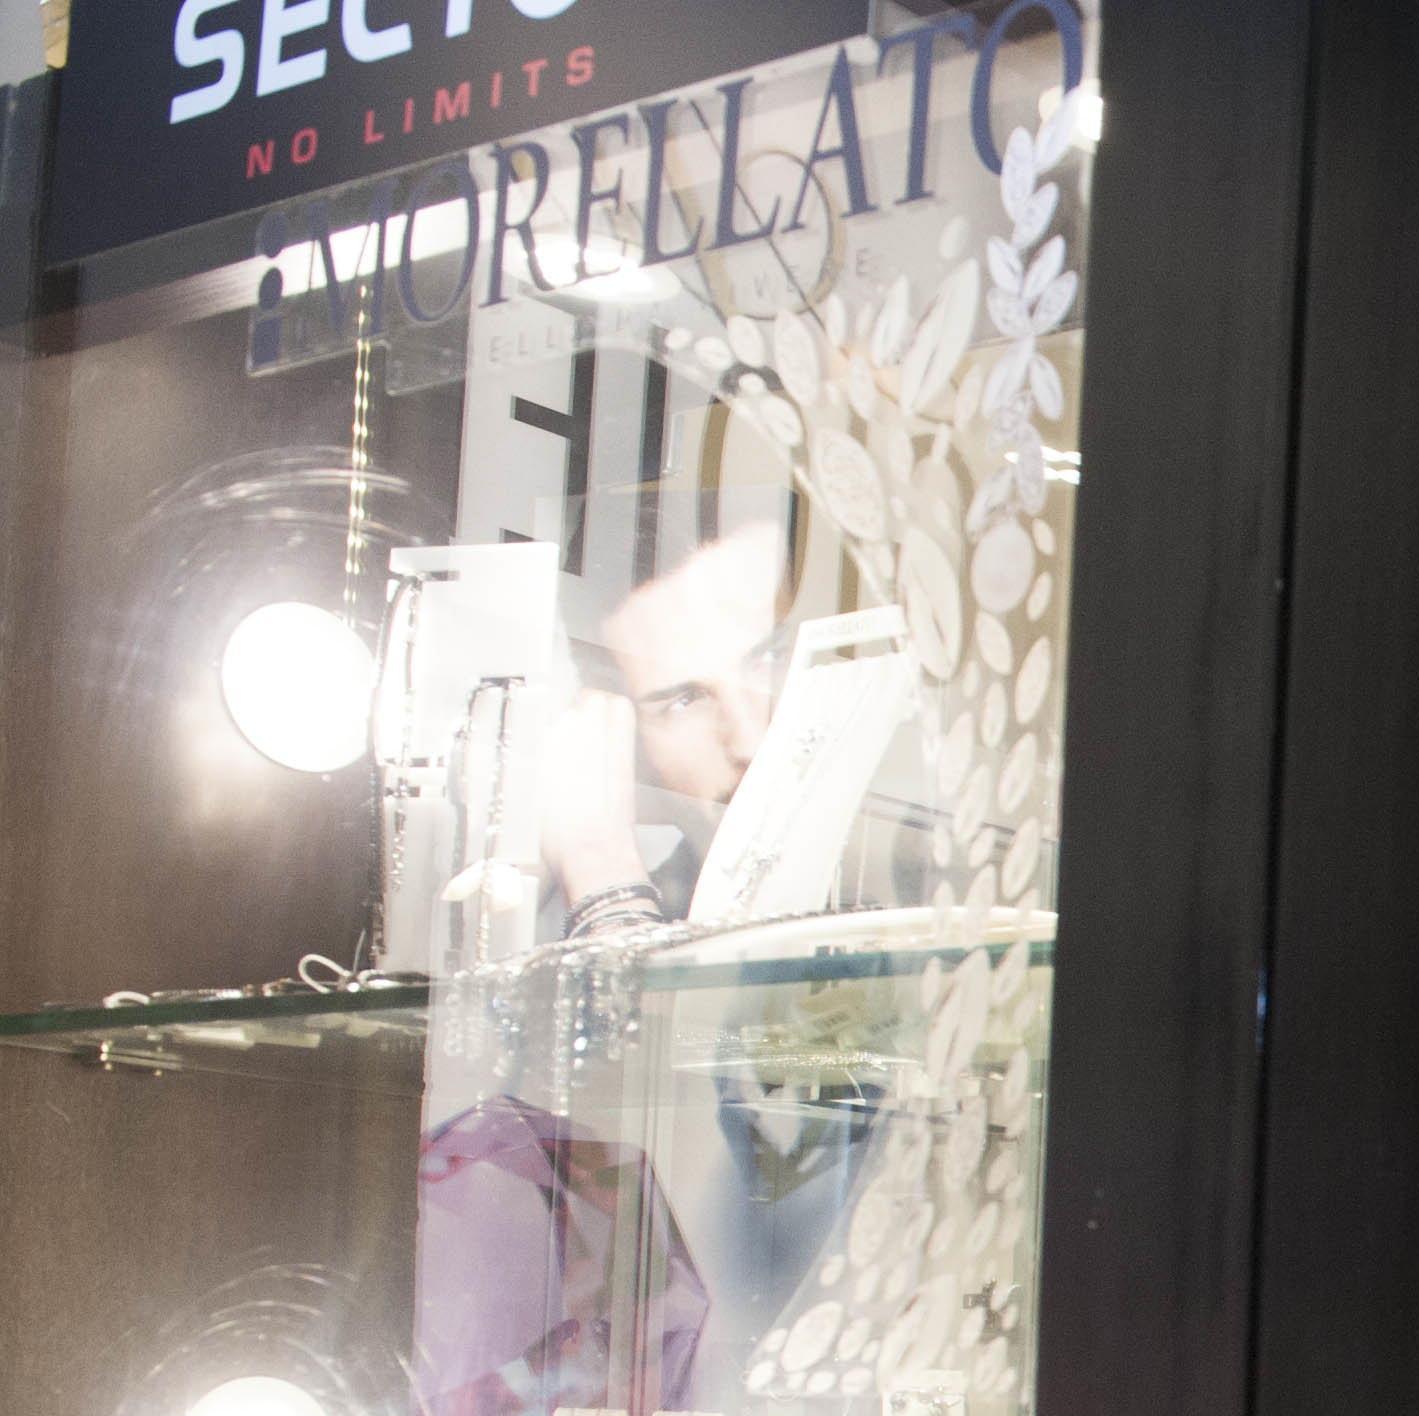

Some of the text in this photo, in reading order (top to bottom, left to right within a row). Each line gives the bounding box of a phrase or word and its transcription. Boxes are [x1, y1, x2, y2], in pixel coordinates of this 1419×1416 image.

[170, 0, 588, 124] SEC
[246, 46, 596, 179] NO LIMITS
[298, 0, 1083, 337] MORELLATO
